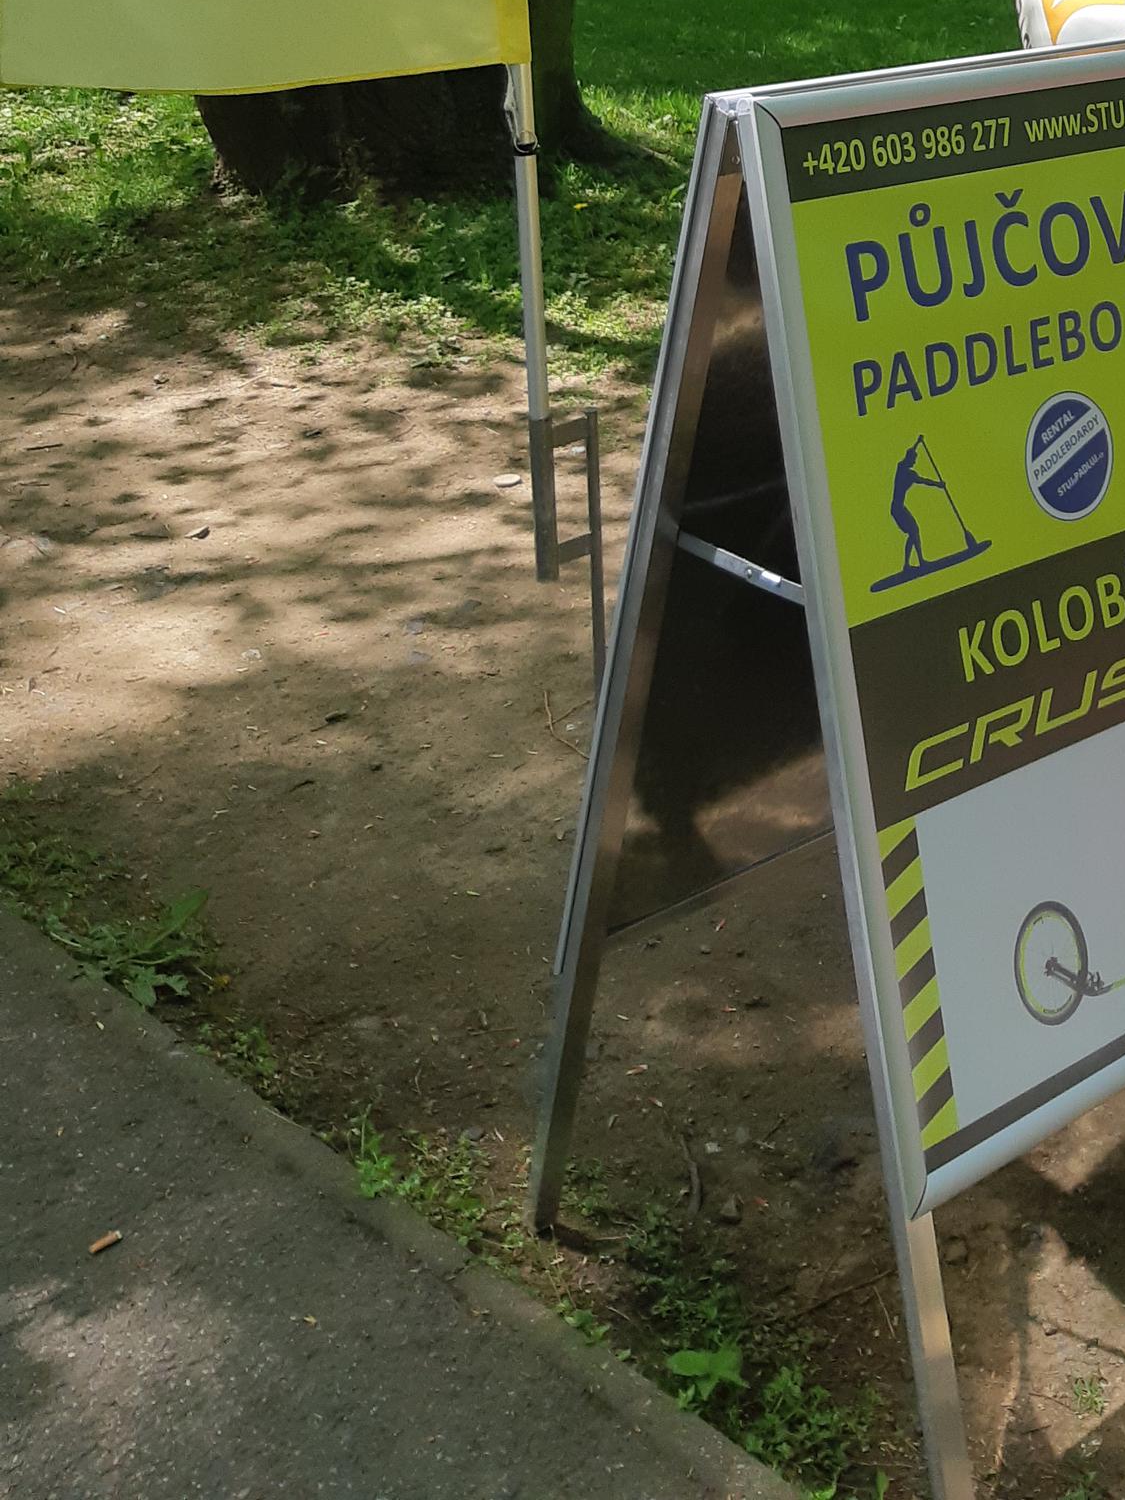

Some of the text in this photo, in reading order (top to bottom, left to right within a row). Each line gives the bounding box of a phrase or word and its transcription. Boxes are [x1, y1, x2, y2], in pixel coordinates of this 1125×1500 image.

[803, 140, 866, 177] +420
[871, 131, 914, 169] 603
[922, 124, 966, 158] 986
[972, 117, 1011, 154] 277
[1033, 414, 1101, 480] PADDLEBOARDY
[1041, 410, 1076, 444] RENTAL
